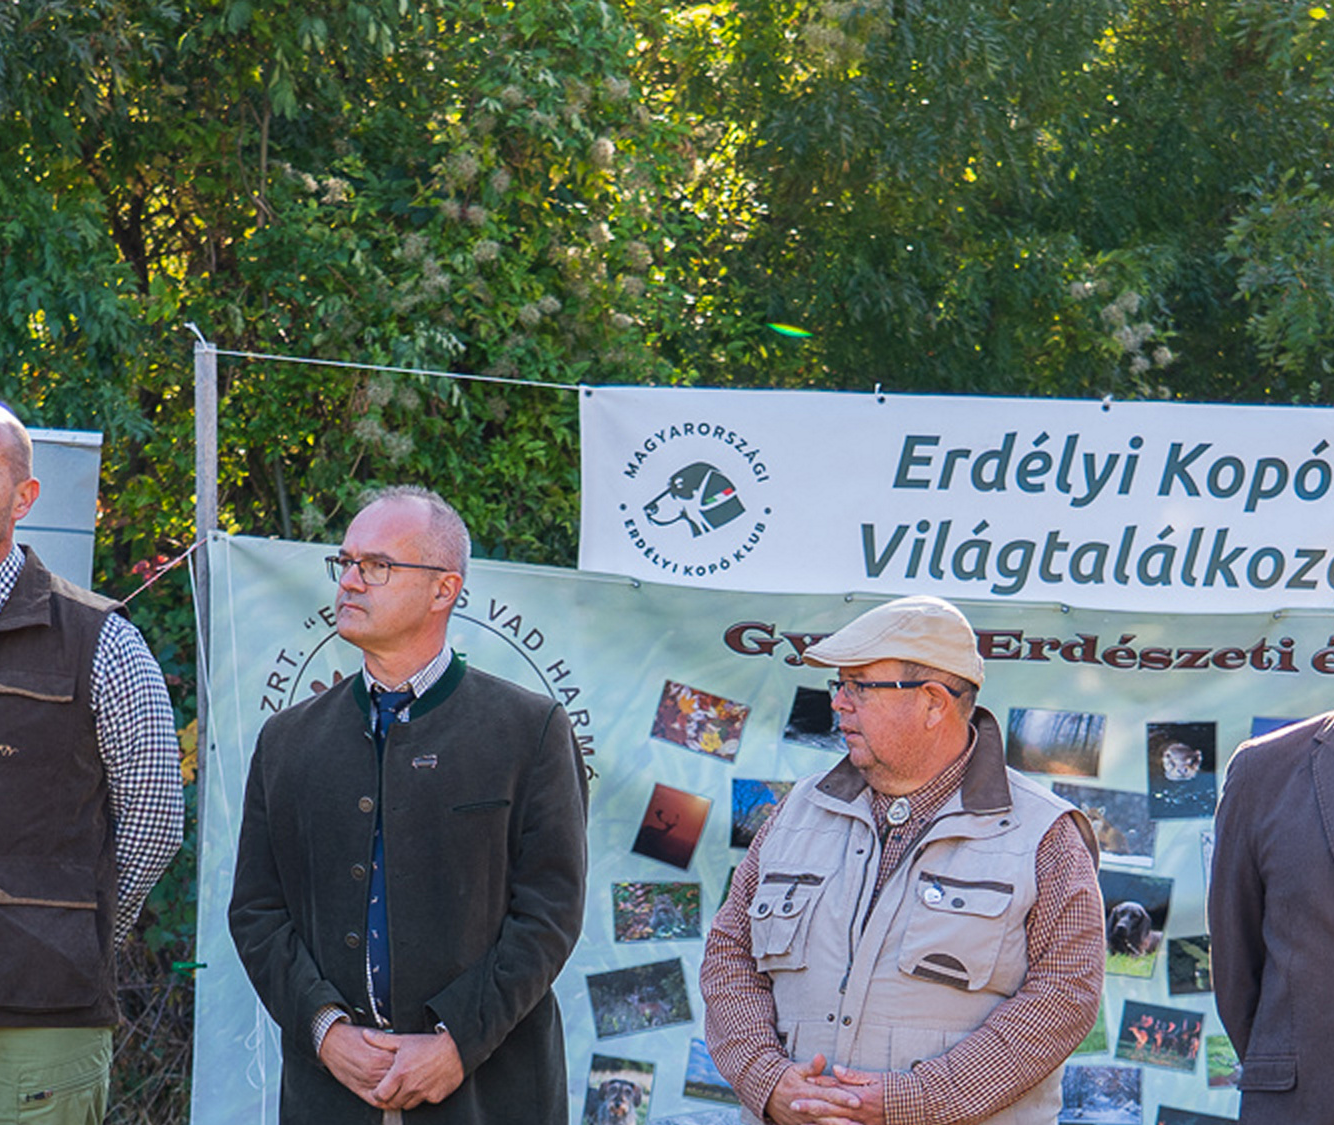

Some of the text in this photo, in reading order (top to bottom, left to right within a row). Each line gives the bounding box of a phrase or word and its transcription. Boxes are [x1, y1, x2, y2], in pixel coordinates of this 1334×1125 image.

[624, 422, 769, 483] MAGYARORSZÁGI
[892, 431, 1333, 512] Erdélyi Kopó
[624, 519, 766, 577] ERDÉLYI KOPÓ KLUB
[260, 648, 304, 713] ZRT.
[489, 599, 545, 651] VAD
[974, 629, 1300, 672] Erdészeti
